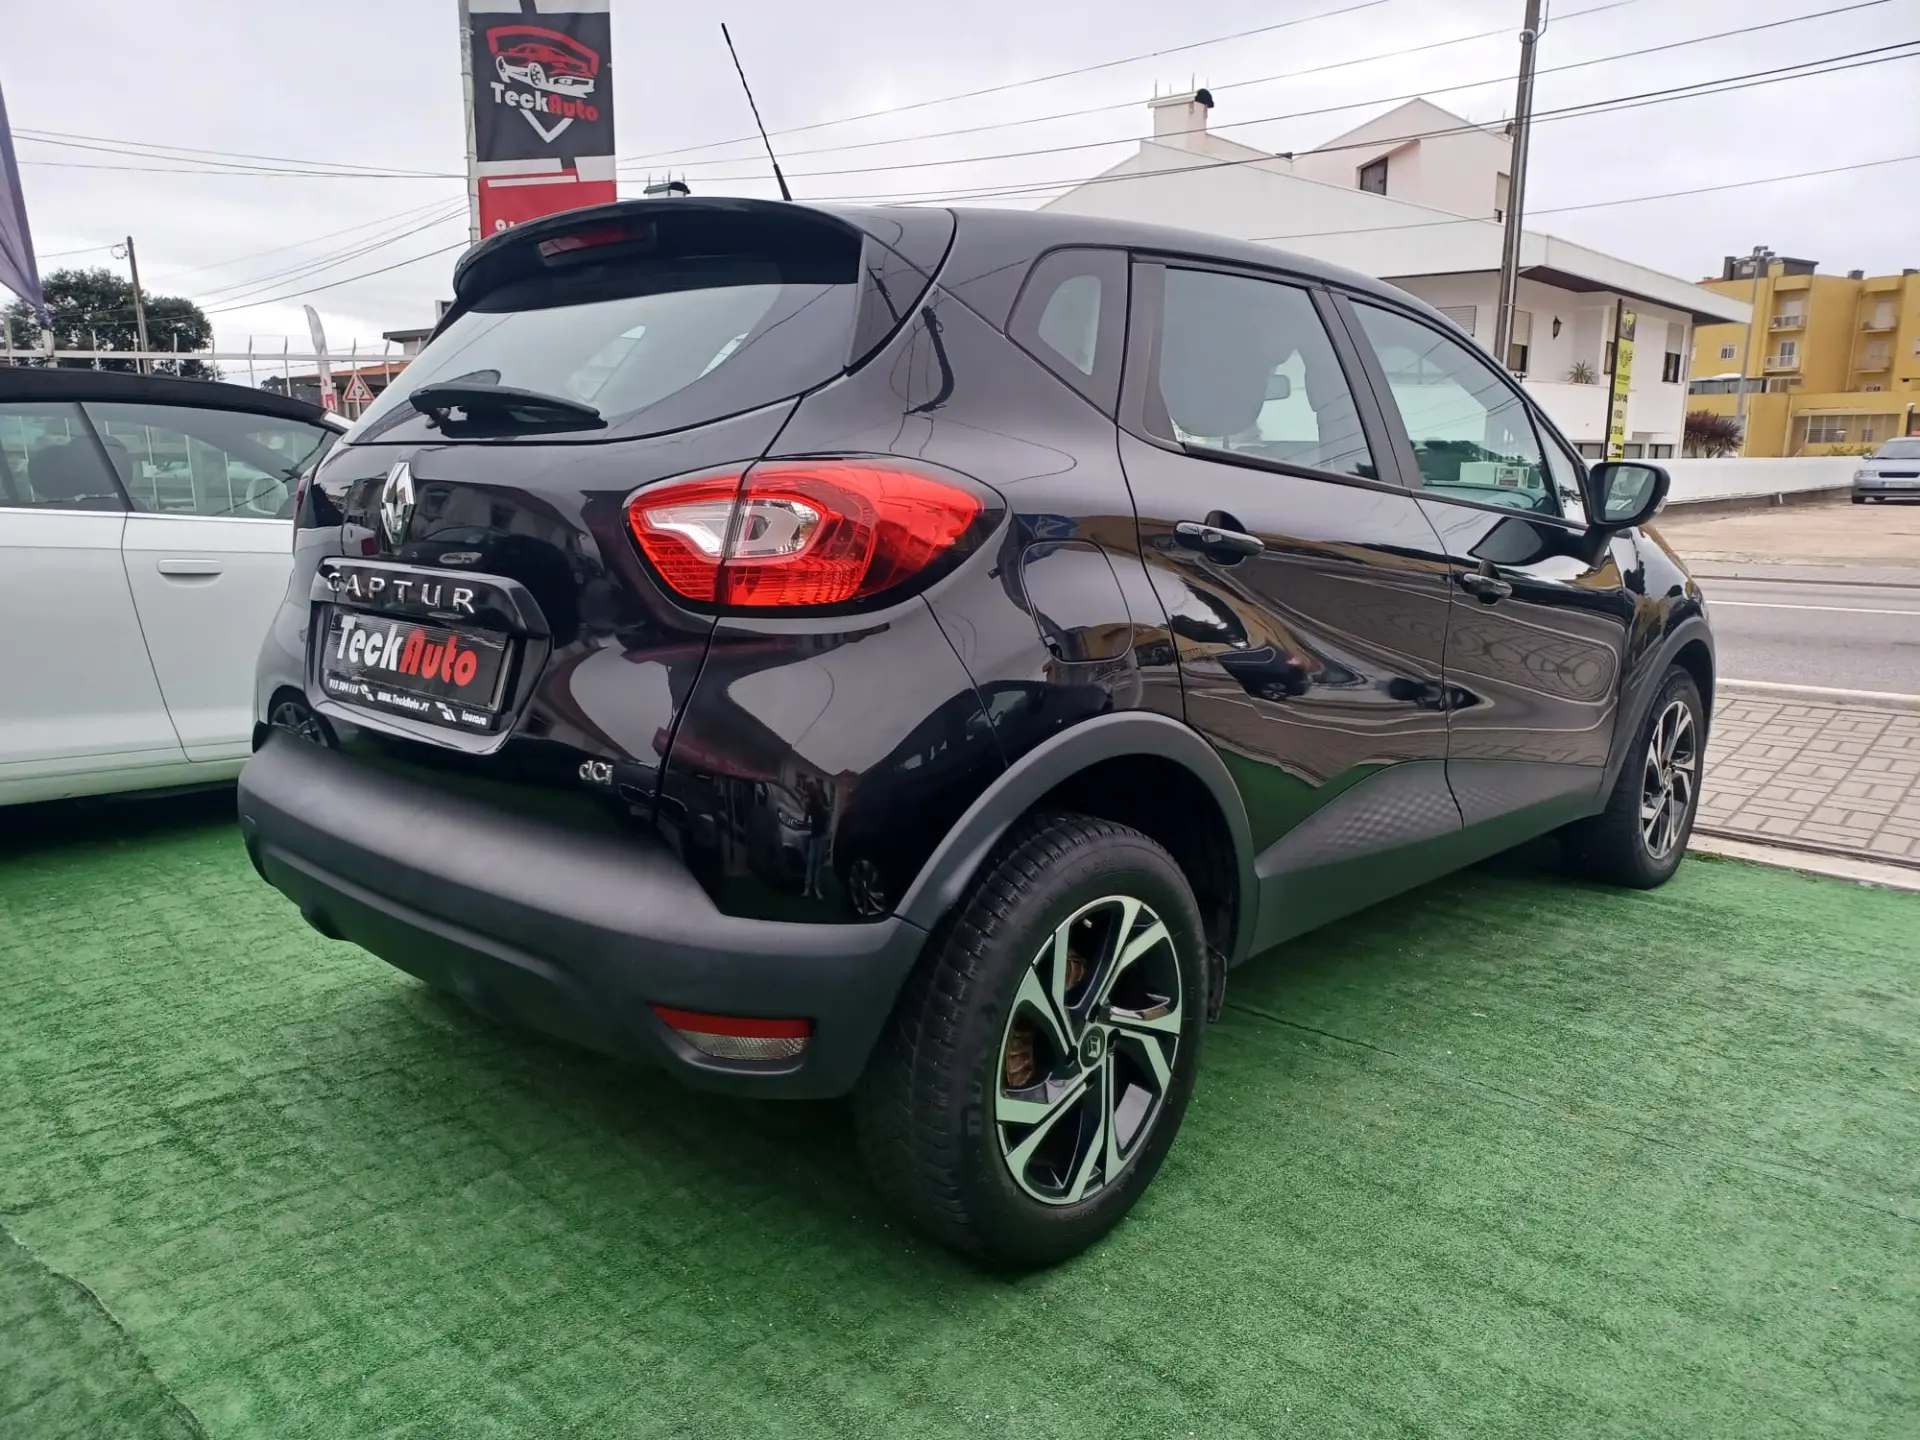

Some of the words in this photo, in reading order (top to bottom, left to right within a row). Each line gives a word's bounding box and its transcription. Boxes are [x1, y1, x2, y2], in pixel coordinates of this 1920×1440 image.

[490, 81, 599, 122] TeckAuto
[327, 572, 475, 614] CAPTUR
[337, 615, 477, 687] TeckAuto
